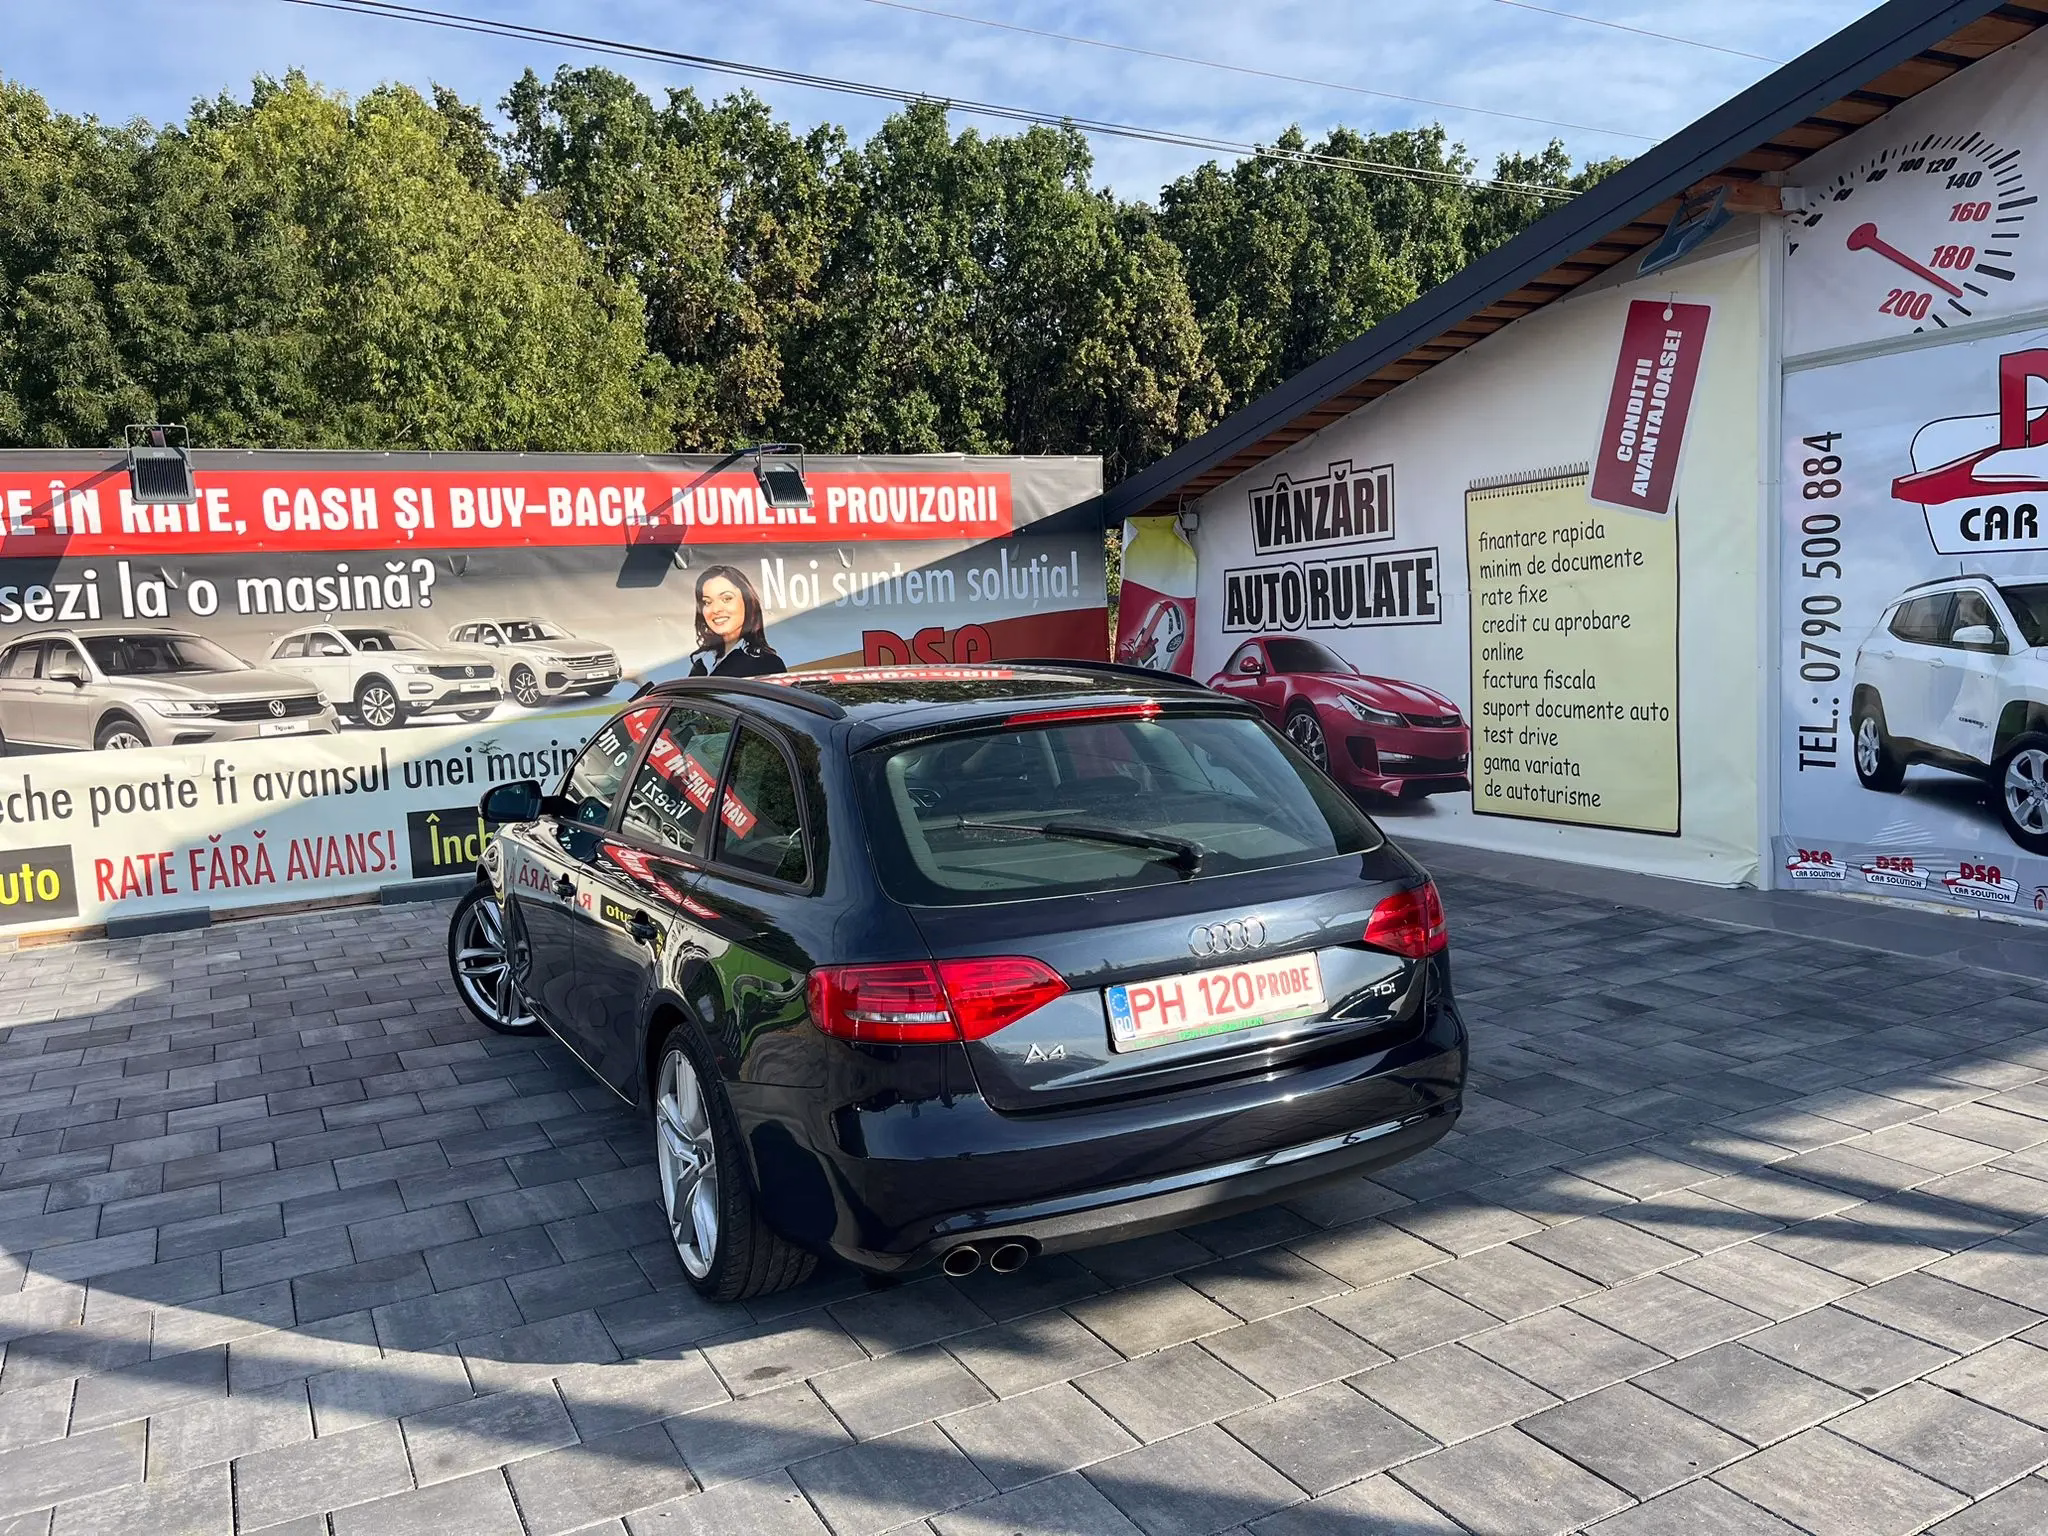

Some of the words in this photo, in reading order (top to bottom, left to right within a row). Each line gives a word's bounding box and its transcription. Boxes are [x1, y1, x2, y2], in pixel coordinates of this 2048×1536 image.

[1897, 157, 1926, 173] 100
[1925, 157, 1957, 174] 120
[1945, 171, 1982, 190] 140
[1949, 201, 1992, 222] 160
[1929, 245, 1976, 270] 180
[1878, 288, 1932, 320] 200
[1617, 358, 1653, 462] CONDITII
[1631, 329, 1683, 498] AVANTAJOASE!
[1802, 431, 1843, 500] 884
[0, 488, 36, 536] E
[48, 479, 103, 535] ÎN
[263, 487, 378, 531] CASH
[394, 486, 435, 540] ȘI
[827, 485, 997, 524] PROVIZORII
[1253, 469, 1389, 548] VÂNZĂRI
[1960, 504, 2038, 541] CAR
[1478, 528, 1547, 553] finantare
[1552, 519, 1605, 549] rapida
[1801, 514, 1842, 579] 500
[1479, 559, 1521, 580] minim
[1527, 555, 1546, 576] de
[1551, 548, 1644, 574] documente
[0, 568, 101, 625] sezi
[118, 560, 169, 620] la
[186, 578, 219, 617] o
[236, 557, 437, 624] mașină?
[760, 557, 821, 610] Noi
[831, 561, 955, 609] suntem
[967, 547, 1079, 609] soluția!
[1227, 570, 1306, 626] AUTO
[1307, 557, 1436, 622] RULATE
[1481, 587, 1513, 607] rate
[1518, 585, 1548, 604] fixe
[1482, 612, 1527, 634] credit
[1532, 617, 1550, 633] cu
[1554, 609, 1631, 637] aprobare
[862, 623, 993, 664] DSA
[1482, 641, 1524, 662] online
[1800, 595, 1842, 682] 0790
[1483, 669, 1538, 690] factura
[1543, 669, 1596, 690] fiscala
[1482, 699, 1530, 722] suport
[1535, 698, 1624, 721] documente
[1630, 702, 1669, 722] auto
[1483, 725, 1514, 744] test
[1519, 726, 1559, 747] drive
[1799, 697, 1841, 772] TEL.:
[1484, 756, 1520, 777] gama
[1525, 758, 1580, 778] variata
[0, 773, 74, 824] che
[89, 772, 198, 828] poate
[212, 758, 239, 805] fi
[252, 746, 391, 803] avansul
[403, 746, 474, 789] unei
[487, 736, 587, 788] mașin
[1484, 779, 1502, 798] de
[1506, 783, 1601, 808] autoturisme
[95, 850, 179, 901] RATE
[190, 830, 275, 890] FĂRĂ
[287, 829, 398, 883] AVANS!
[1798, 849, 1833, 864] DSA
[1876, 856, 1914, 873] DSA
[1810, 870, 1841, 878] SOLUTION
[1887, 876, 1922, 888] SOLUTION
[1960, 862, 2001, 884] DSA
[1954, 886, 1968, 895] CAR
[1971, 889, 2010, 901] SOLUTION
[1128, 983, 1187, 1030] PH
[1199, 971, 1255, 1017] 120
[1256, 966, 1313, 1000] PROBE
[1370, 982, 1396, 997] TDI
[1116, 1016, 1132, 1033] RO
[1023, 1042, 1067, 1066] A4
